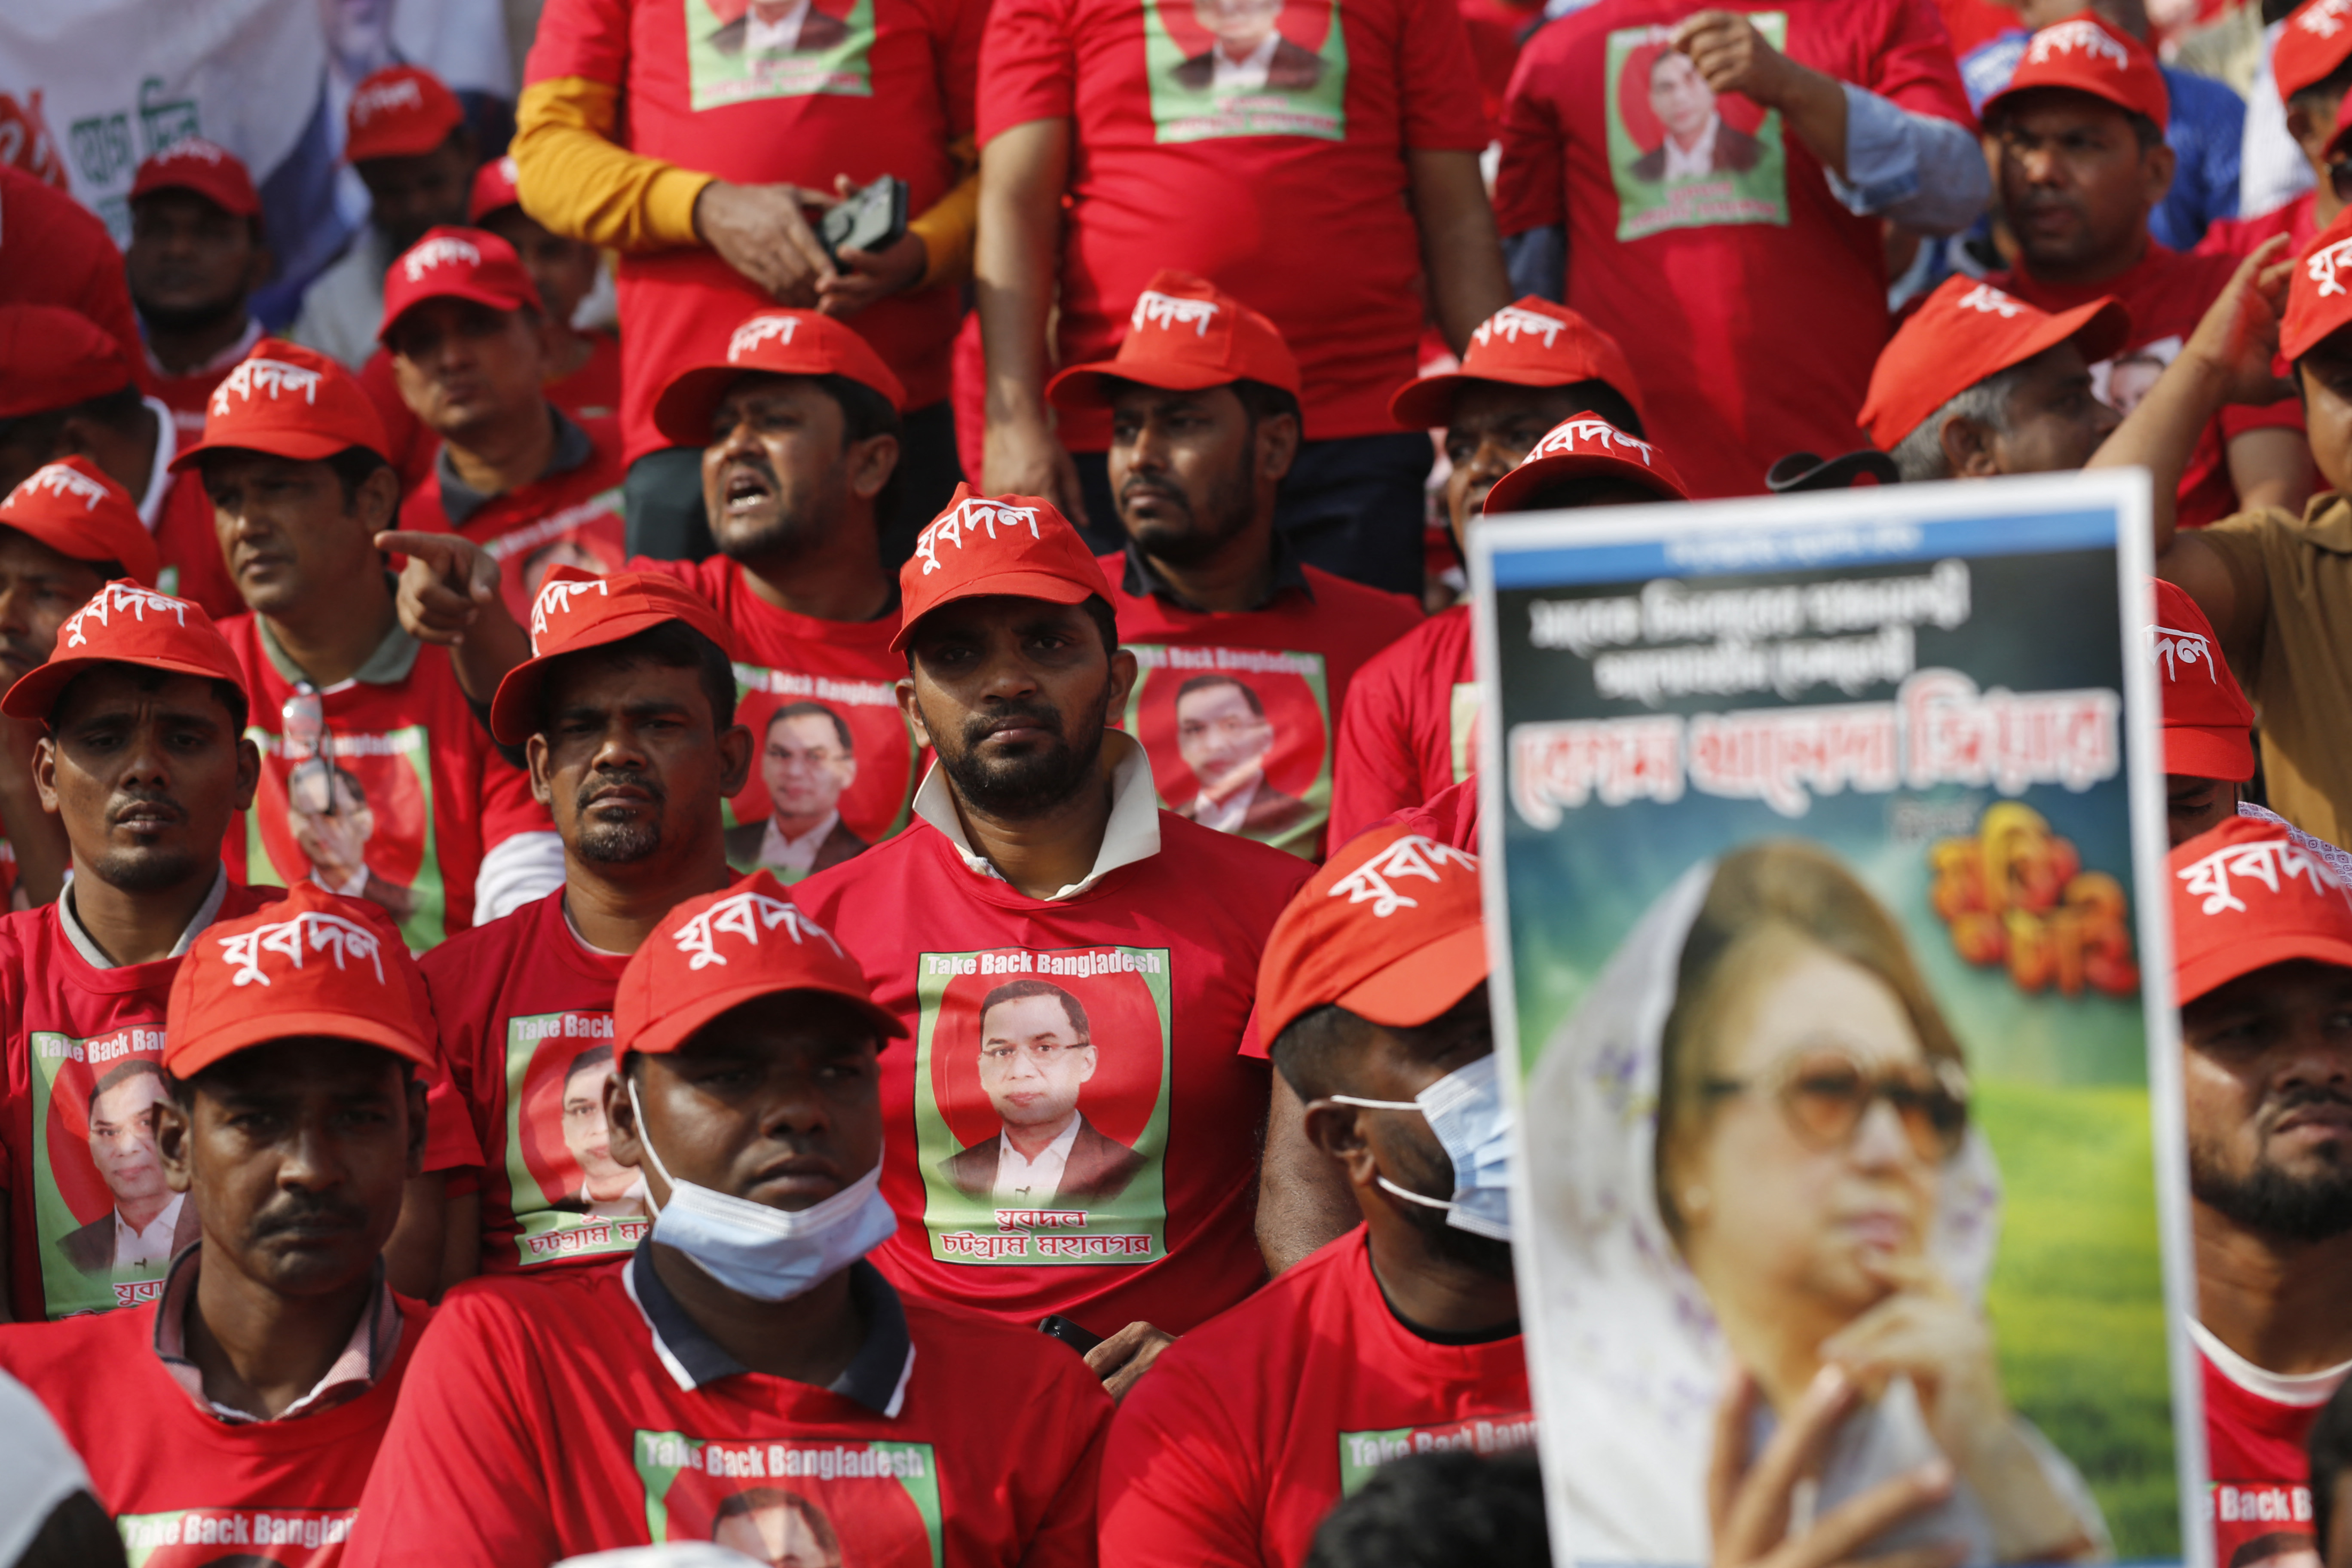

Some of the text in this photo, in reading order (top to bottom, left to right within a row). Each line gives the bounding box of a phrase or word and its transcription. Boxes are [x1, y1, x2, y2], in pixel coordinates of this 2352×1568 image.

[916, 498, 1040, 575] যুবদল
[66, 583, 189, 648] যুবদল
[217, 911, 386, 986] যুবদল
[928, 950, 1161, 979] Take Back Bangladesh
[517, 1014, 614, 1041] Take Back
[39, 1036, 84, 1063] Take
[88, 1032, 130, 1064] Back
[994, 1209, 1088, 1232] যুবদল
[940, 1231, 1152, 1259] চট্টগ্রাম মহানগর
[706, 1444, 766, 1477] Back
[767, 1444, 925, 1480] Bangladesh
[2219, 1486, 2291, 1522] Back
[126, 1513, 355, 1549] Take Back Bangla
